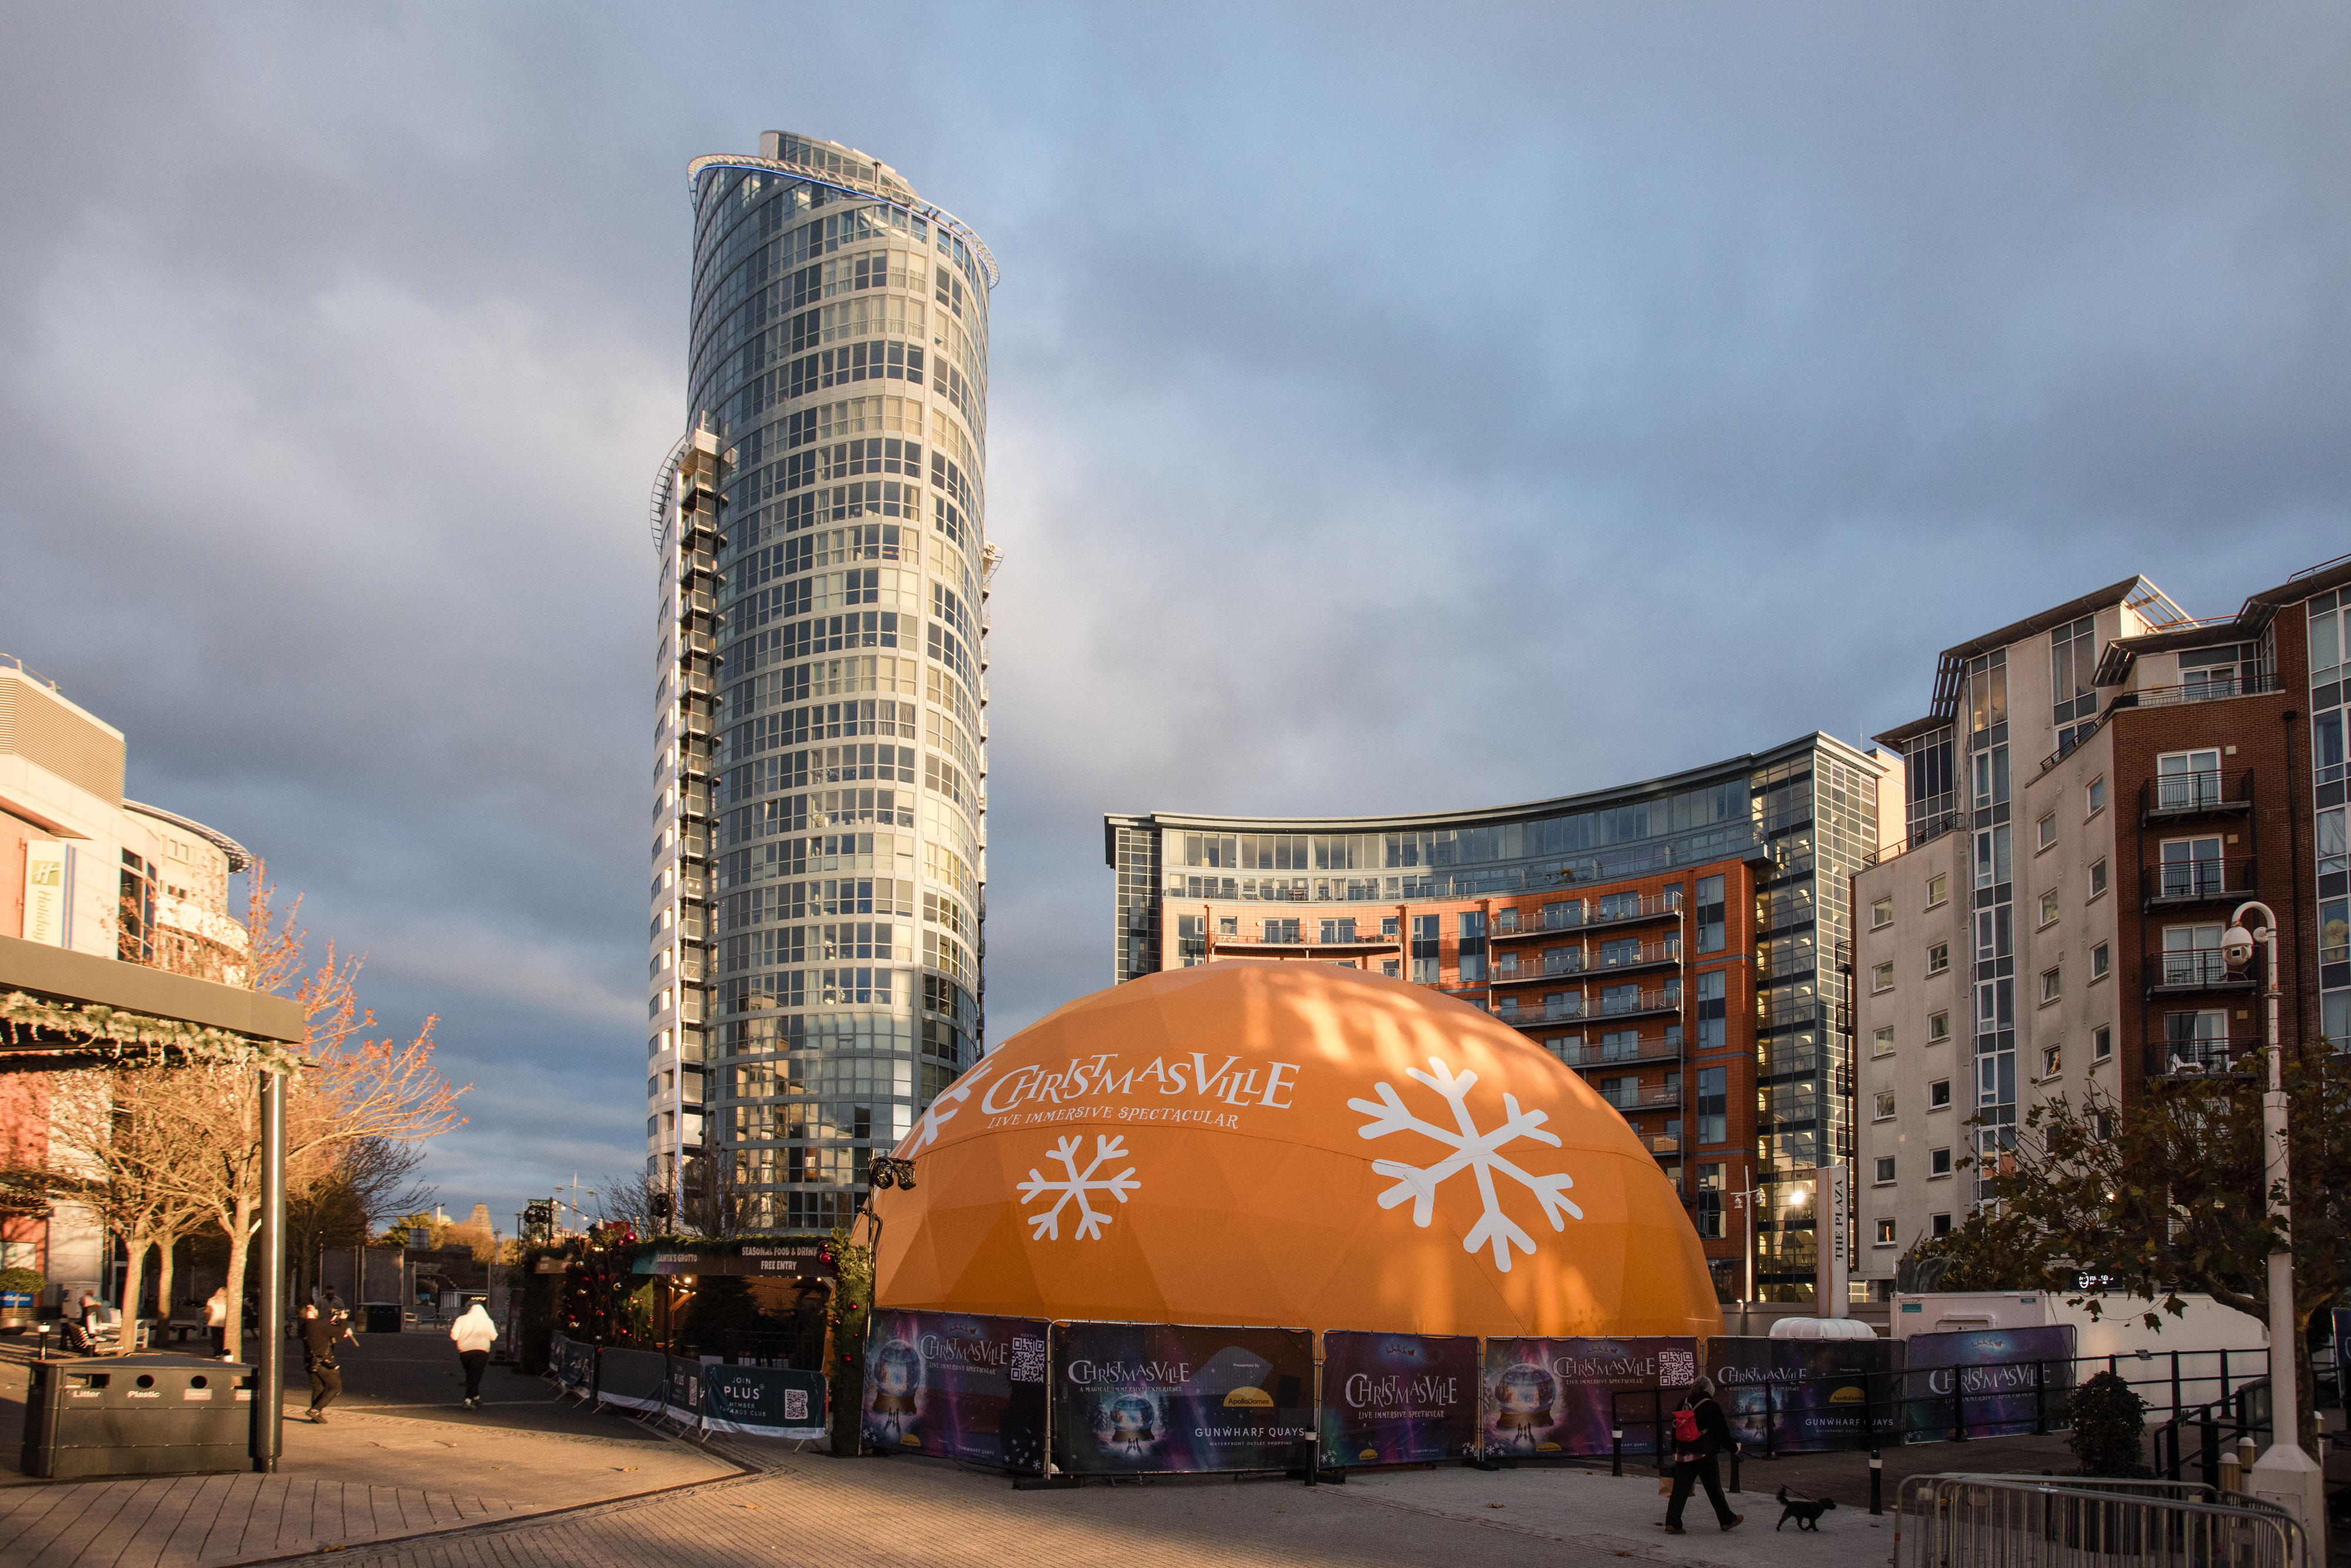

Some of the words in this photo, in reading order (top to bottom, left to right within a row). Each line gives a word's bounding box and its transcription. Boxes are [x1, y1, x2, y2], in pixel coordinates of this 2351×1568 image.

[32, 890, 52, 941] Holiday
[981, 1052, 1300, 1115] CHRISTMASVILLE
[987, 1114, 1022, 1129] LIVE
[1024, 1106, 1114, 1124] IMMERSIVE
[1118, 1107, 1238, 1130] SPECTACULAR
[1835, 1179, 1843, 1227] PLAZA
[742, 1247, 773, 1257] SEASONAL
[773, 1247, 790, 1256] FOOD
[791, 1247, 796, 1256] &
[1835, 1231, 1843, 1261] THE
[656, 1254, 677, 1262] SANTA'S
[678, 1254, 698, 1262] GROTTO
[761, 1260, 776, 1270] FREE
[776, 1260, 797, 1271] ENTRY
[920, 1335, 1008, 1365] CHRISTMASVILLE
[940, 1363, 965, 1371] IMMERSIVE
[966, 1365, 996, 1375] SPECTACULAR
[1069, 1359, 1190, 1384] CHRISTMASVILLE
[1552, 1356, 1655, 1378] CHRISTMASVILLE
[128, 1391, 160, 1399] Plastic
[724, 1385, 760, 1400] PLUS
[1345, 1373, 1458, 1408] CHRISTMASVILLE
[1359, 1411, 1372, 1419] LIVE
[1375, 1410, 1407, 1419] IMMERSIVE
[1408, 1410, 1444, 1419] SPECTACULAR
[1805, 1418, 1860, 1427] GUNWHARF
[1195, 1427, 1265, 1438] GUNWHARF
[1268, 1428, 1304, 1438] QUAYS
